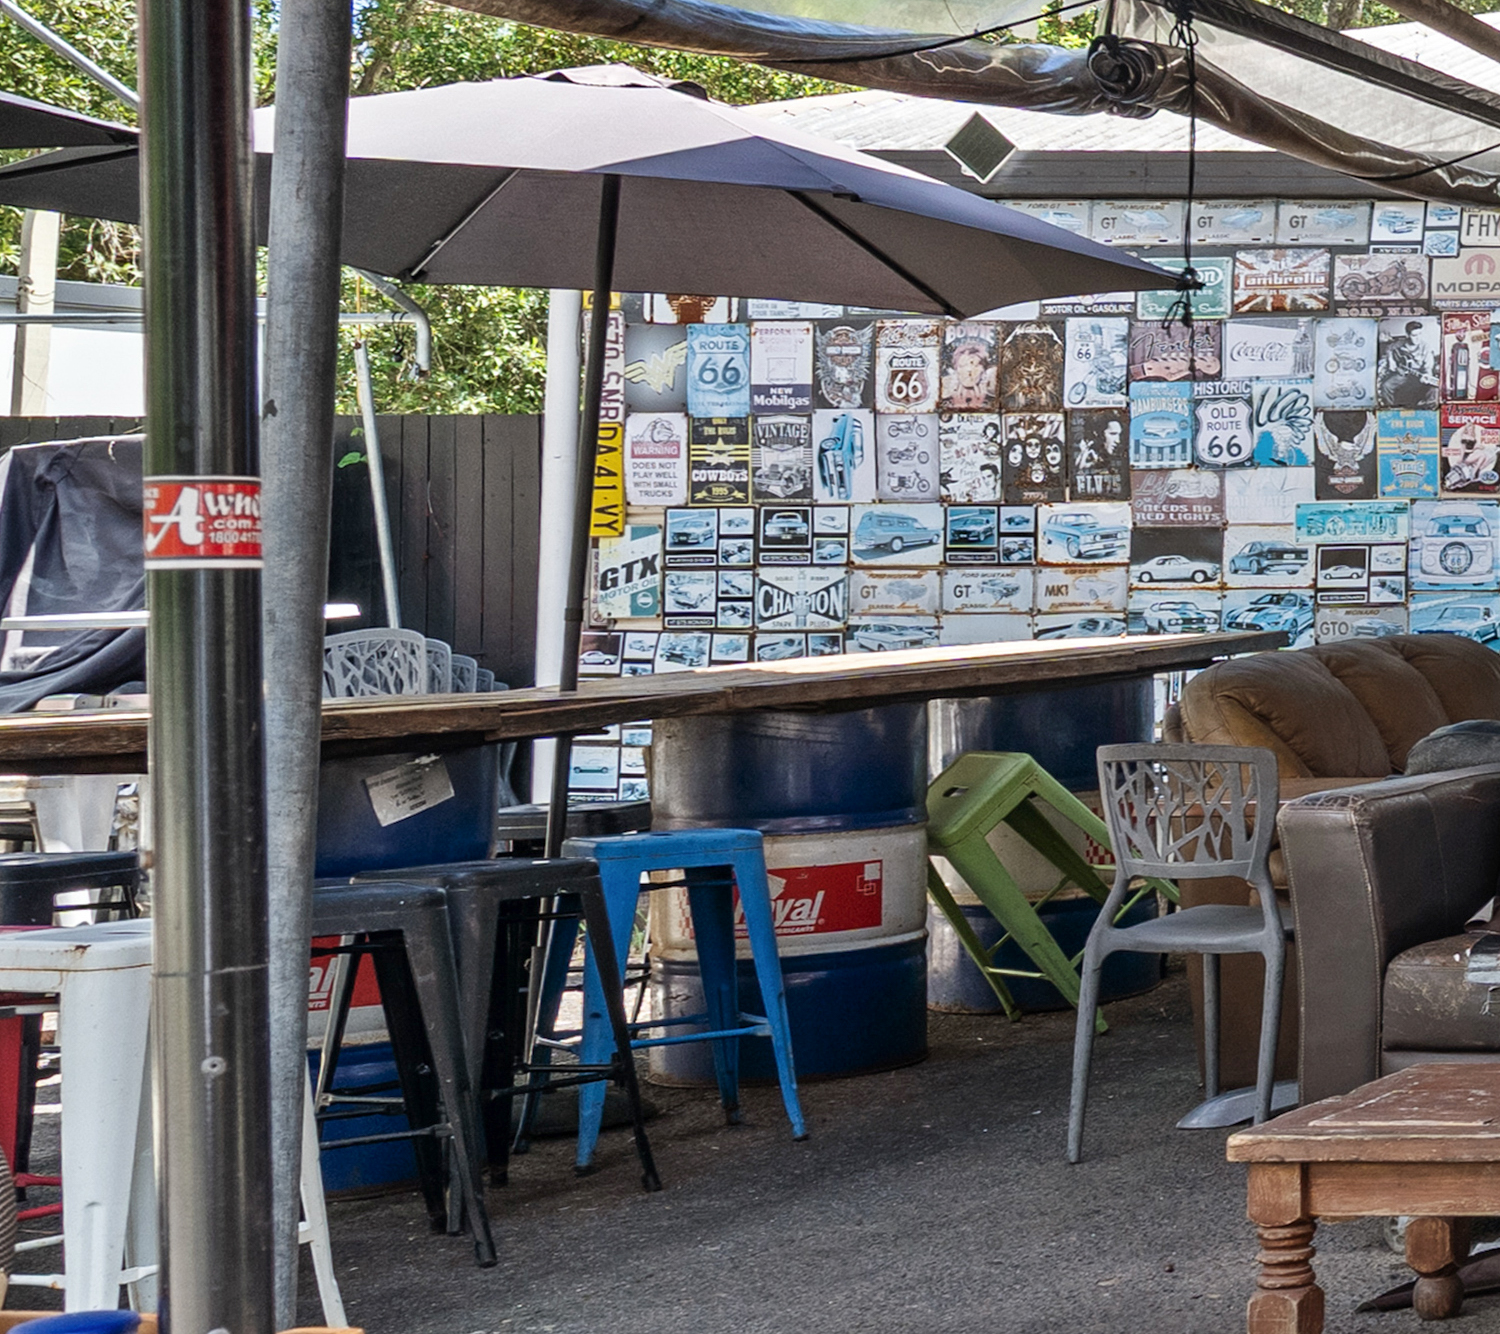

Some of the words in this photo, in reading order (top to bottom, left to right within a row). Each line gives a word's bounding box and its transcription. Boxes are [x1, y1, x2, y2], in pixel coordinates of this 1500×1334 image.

[1101, 217, 1117, 230] GT
[1197, 216, 1213, 229] GT
[1289, 215, 1308, 229] GT
[1465, 214, 1500, 237] FHY
[1241, 270, 1325, 289] Lambretta
[700, 339, 740, 351] ROUTE
[1076, 348, 1092, 361] 66
[891, 357, 924, 368] ROUTE
[698, 356, 742, 386] 66
[769, 387, 793, 395] NEW
[892, 374, 923, 399] 66
[1194, 381, 1251, 395] HISTORIC
[753, 394, 811, 409] Mobilgas
[1131, 397, 1189, 417] HAMBURGERS
[1210, 407, 1238, 419] OLD
[1207, 421, 1242, 431] ROUTE
[1448, 415, 1497, 425] SERVICE
[757, 423, 810, 440] VINTAGE
[633, 445, 679, 457] WARNING
[1207, 434, 1243, 458] 66
[632, 462, 655, 470] DOES
[659, 462, 677, 470] NOT
[632, 471, 656, 480] PLAY
[657, 471, 678, 480] WELL
[691, 469, 749, 482] COWBOYS
[632, 480, 652, 489] WITH
[653, 480, 678, 489] SMALL
[639, 489, 673, 498] TRUCKS
[601, 549, 660, 592] GTX
[953, 583, 970, 598] GT
[1319, 621, 1350, 636] GTO
